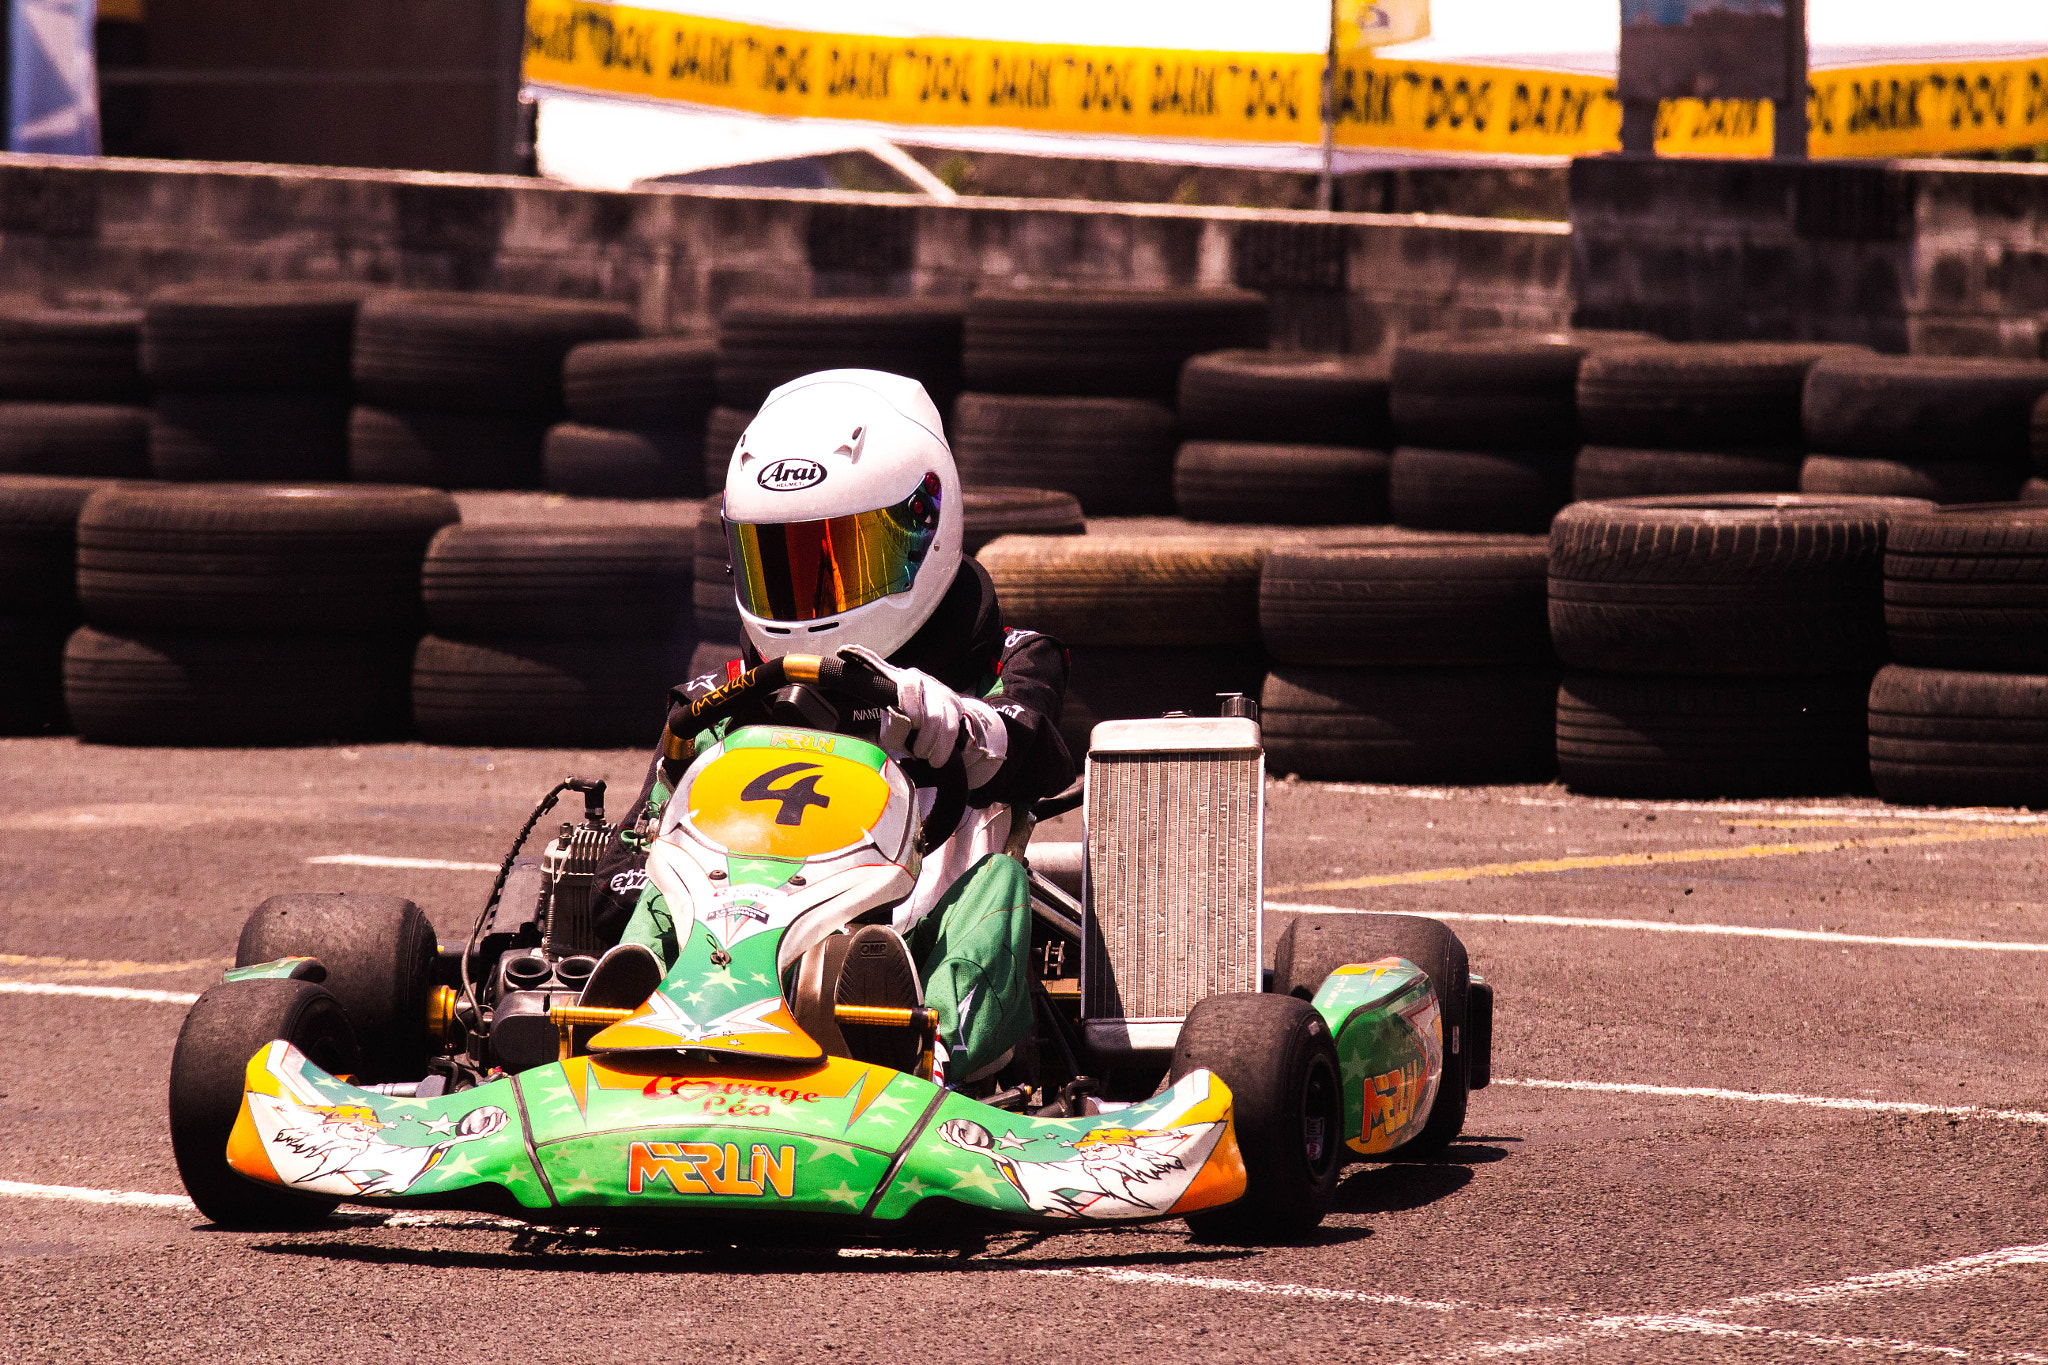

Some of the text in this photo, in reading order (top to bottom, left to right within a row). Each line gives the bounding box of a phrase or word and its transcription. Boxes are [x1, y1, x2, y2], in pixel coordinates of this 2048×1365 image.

[761, 462, 818, 484] Arai
[770, 731, 836, 753] MERLIN
[740, 762, 830, 826] 4
[861, 944, 886, 955] OMP
[642, 1074, 821, 1105] Courage
[694, 1096, 770, 1117] Léa
[628, 1141, 796, 1198] MERLIN
